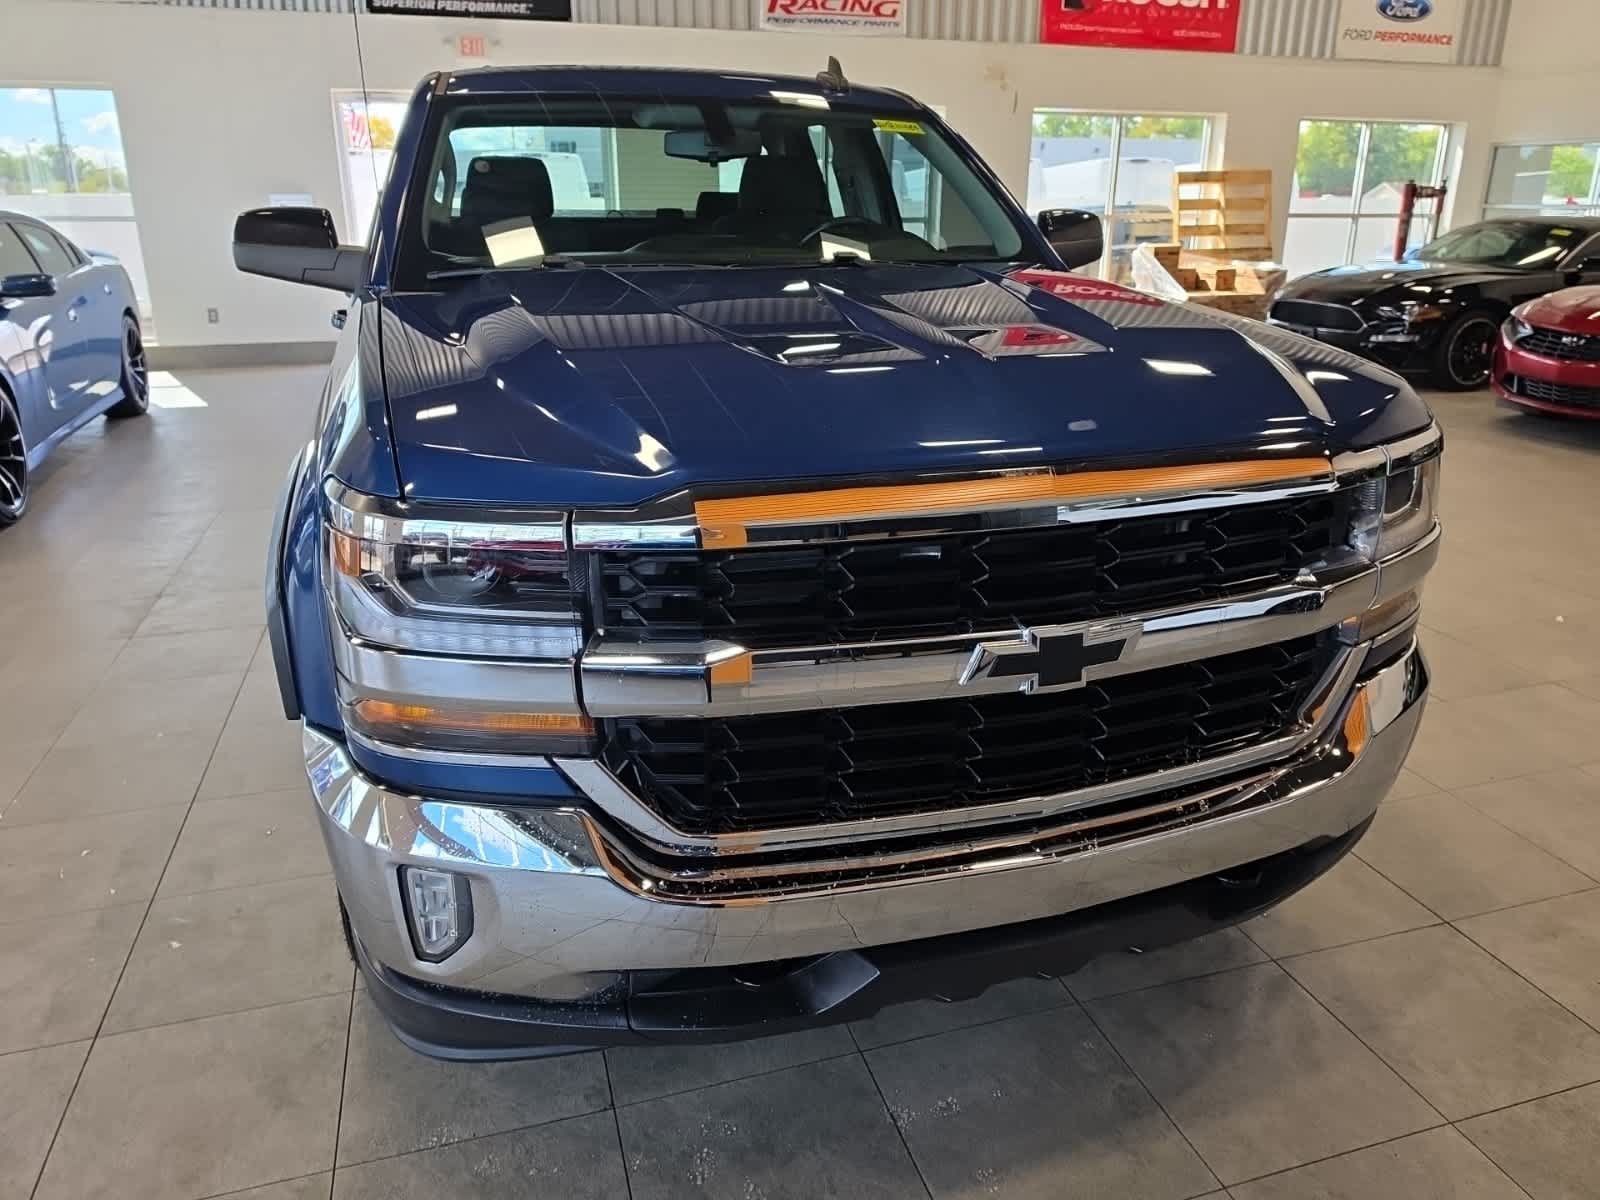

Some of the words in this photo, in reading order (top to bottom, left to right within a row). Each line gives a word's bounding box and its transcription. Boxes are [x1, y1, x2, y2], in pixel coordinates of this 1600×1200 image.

[372, 0, 435, 10] SUPERIOR
[767, 0, 900, 18] RACING
[1386, 0, 1423, 17] Ford
[766, 16, 861, 26] PERFORMANCE
[1342, 28, 1373, 41] FORD
[1374, 30, 1453, 46] PERFORMANCE
